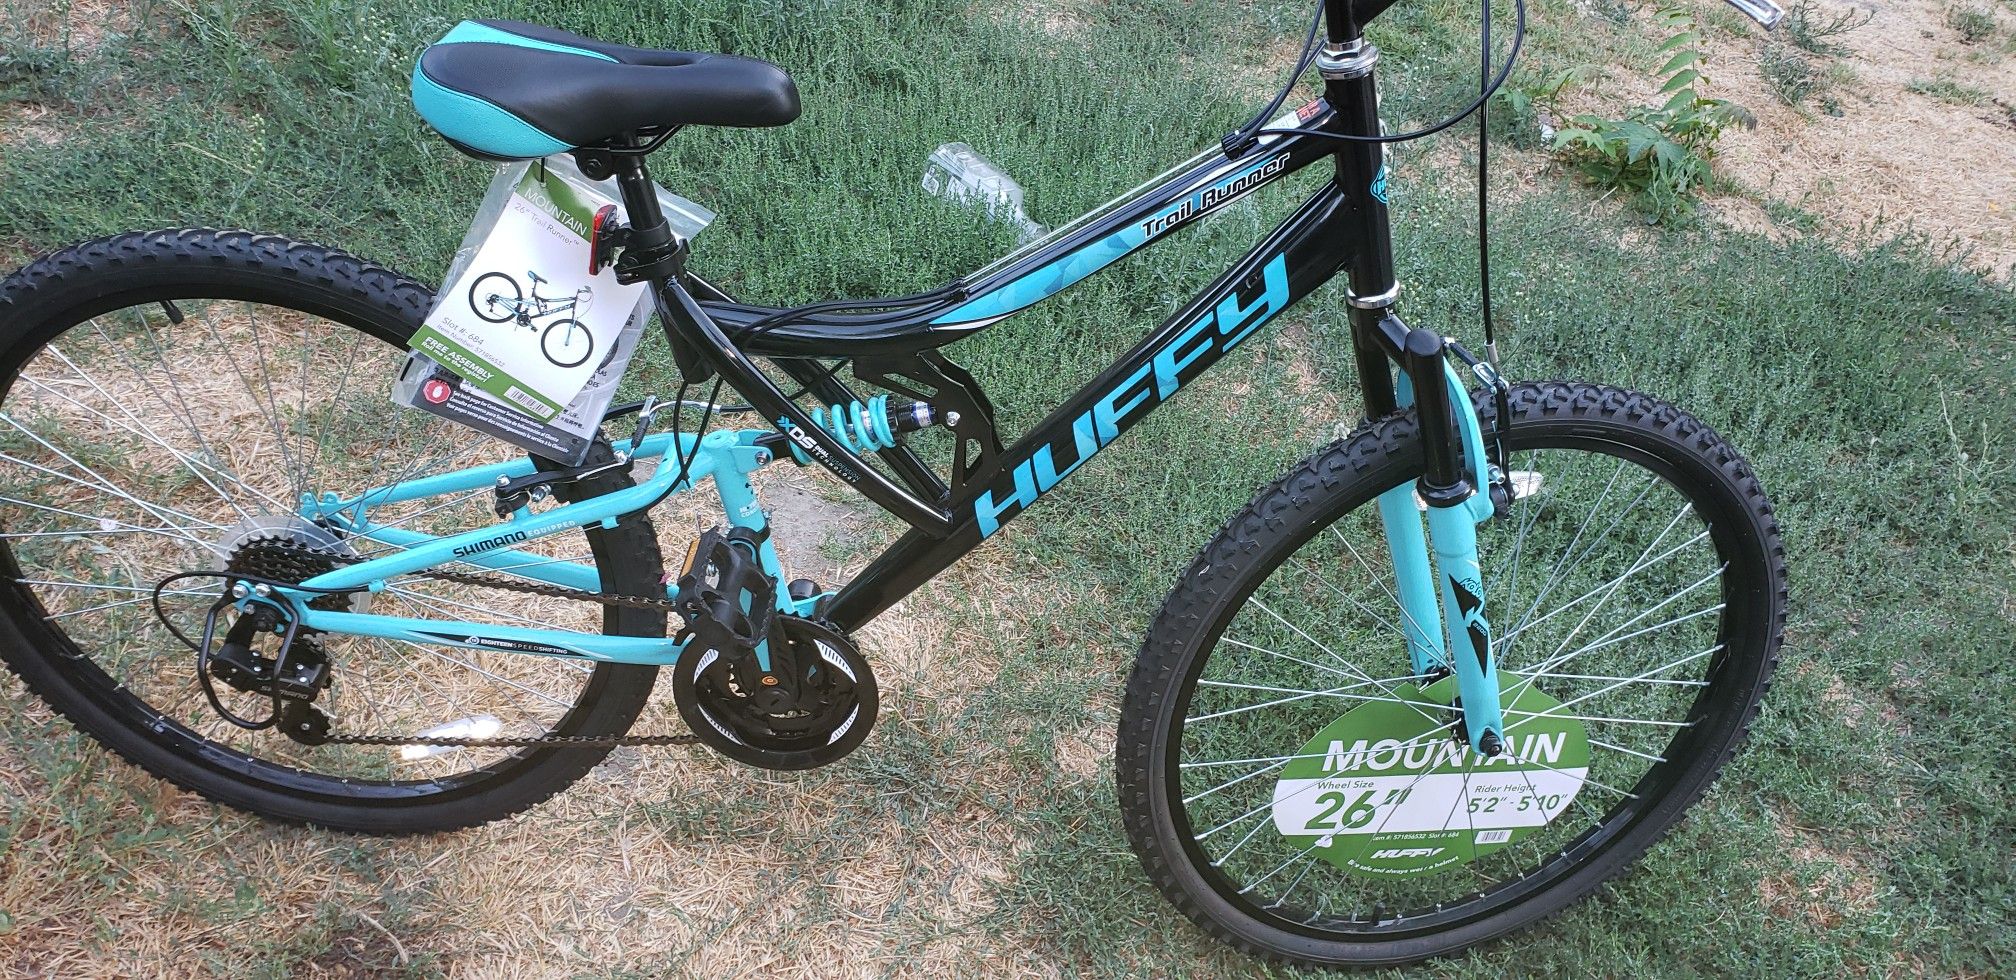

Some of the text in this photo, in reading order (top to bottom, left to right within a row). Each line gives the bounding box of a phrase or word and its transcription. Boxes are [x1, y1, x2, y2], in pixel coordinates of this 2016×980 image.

[1141, 152, 1291, 239] Trail Runner
[524, 187, 588, 236] MOUNTAIN
[531, 211, 547, 227] Trail
[437, 324, 450, 335] Item
[442, 317, 458, 331] Slot
[468, 333, 484, 345] 684
[421, 341, 434, 352] Roll
[433, 349, 444, 357] me
[451, 359, 462, 368] the
[424, 336, 450, 353] FREE
[448, 351, 495, 380] ASSEMBLY
[974, 252, 1290, 539] HUFFY
[486, 403, 507, 415] Customer
[505, 410, 521, 421] Service
[520, 416, 544, 429] Information
[811, 449, 857, 483] TECHNOLOGY
[815, 445, 861, 482] DUAL SUSPENSION
[453, 520, 576, 558] SHIMANO EQUIPPED
[1322, 731, 1566, 772] MOUNAIN
[1317, 780, 1375, 790] Wheel Size
[1475, 783, 1537, 794] Rider Height
[1370, 847, 1446, 859] HUFFY
[1435, 855, 1460, 868] helmet
